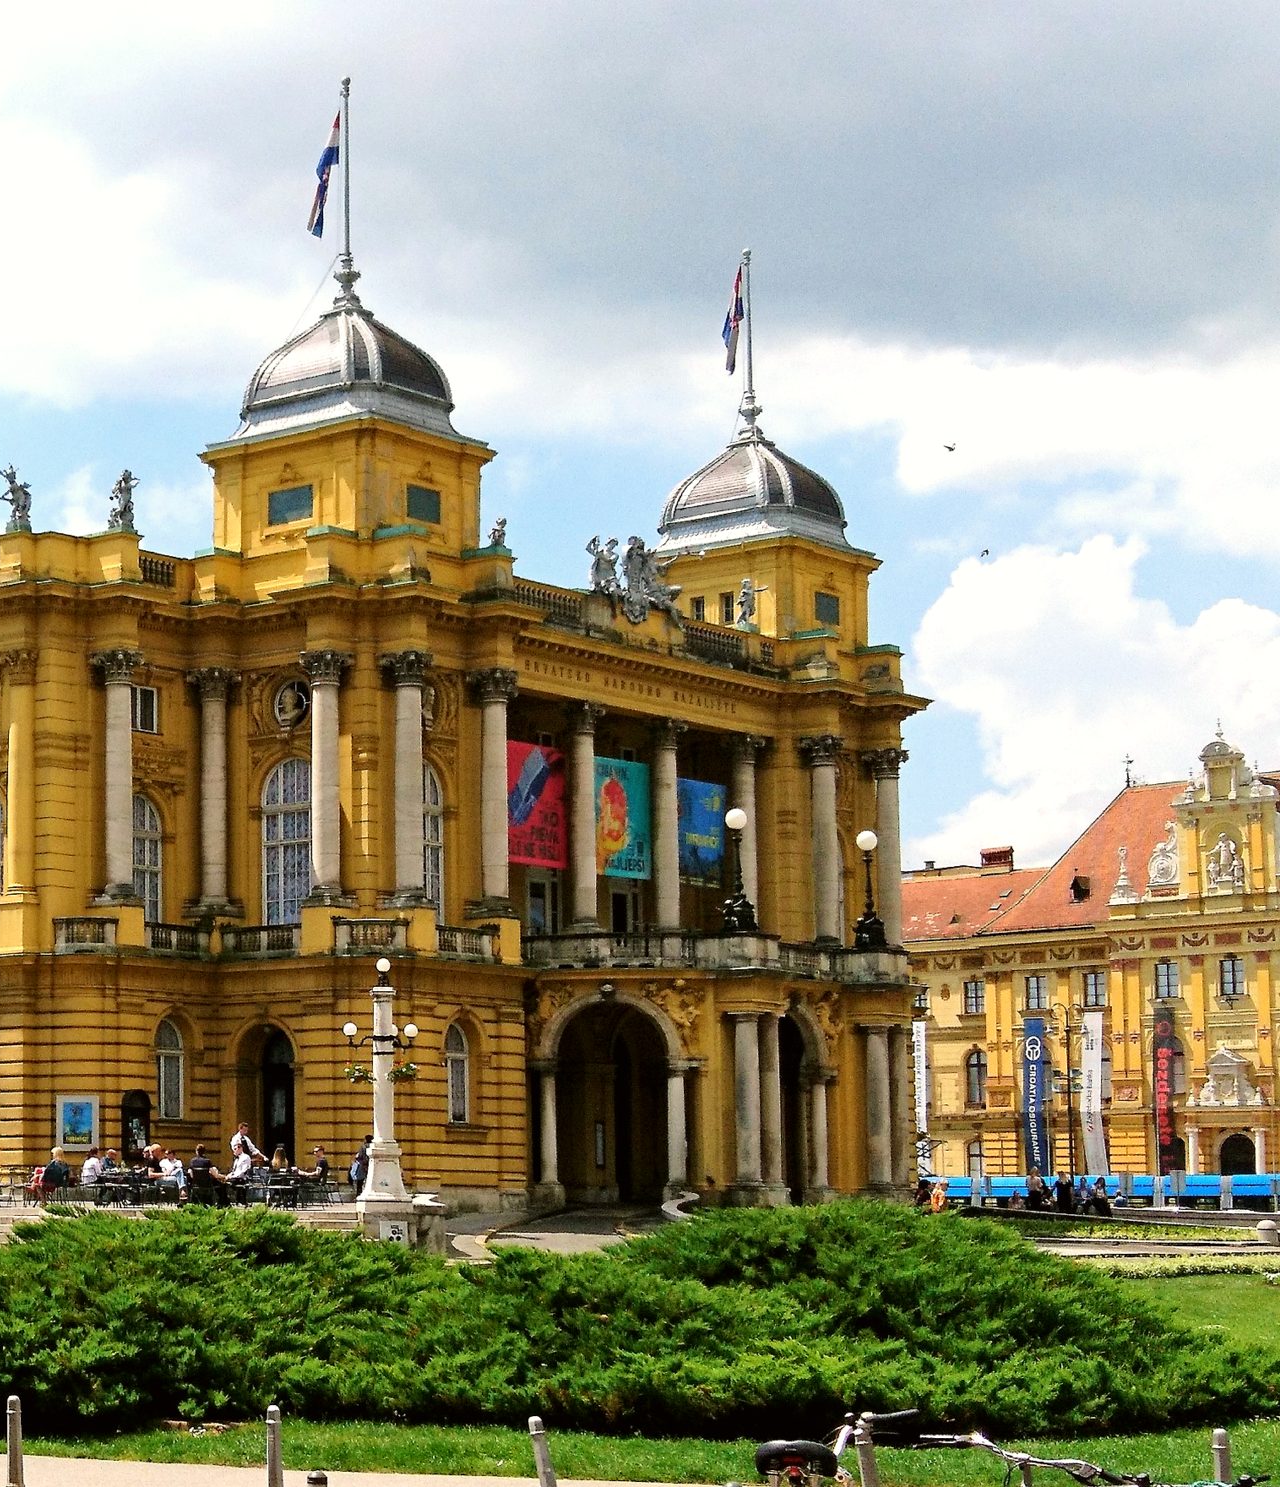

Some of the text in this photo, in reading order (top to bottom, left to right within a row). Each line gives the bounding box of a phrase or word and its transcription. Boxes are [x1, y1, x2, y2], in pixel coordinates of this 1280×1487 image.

[524, 659, 591, 683] HRVATSKO
[603, 676, 661, 698] NARODNO
[1029, 1064, 1040, 1162] CROATIA OSIGURANJE
